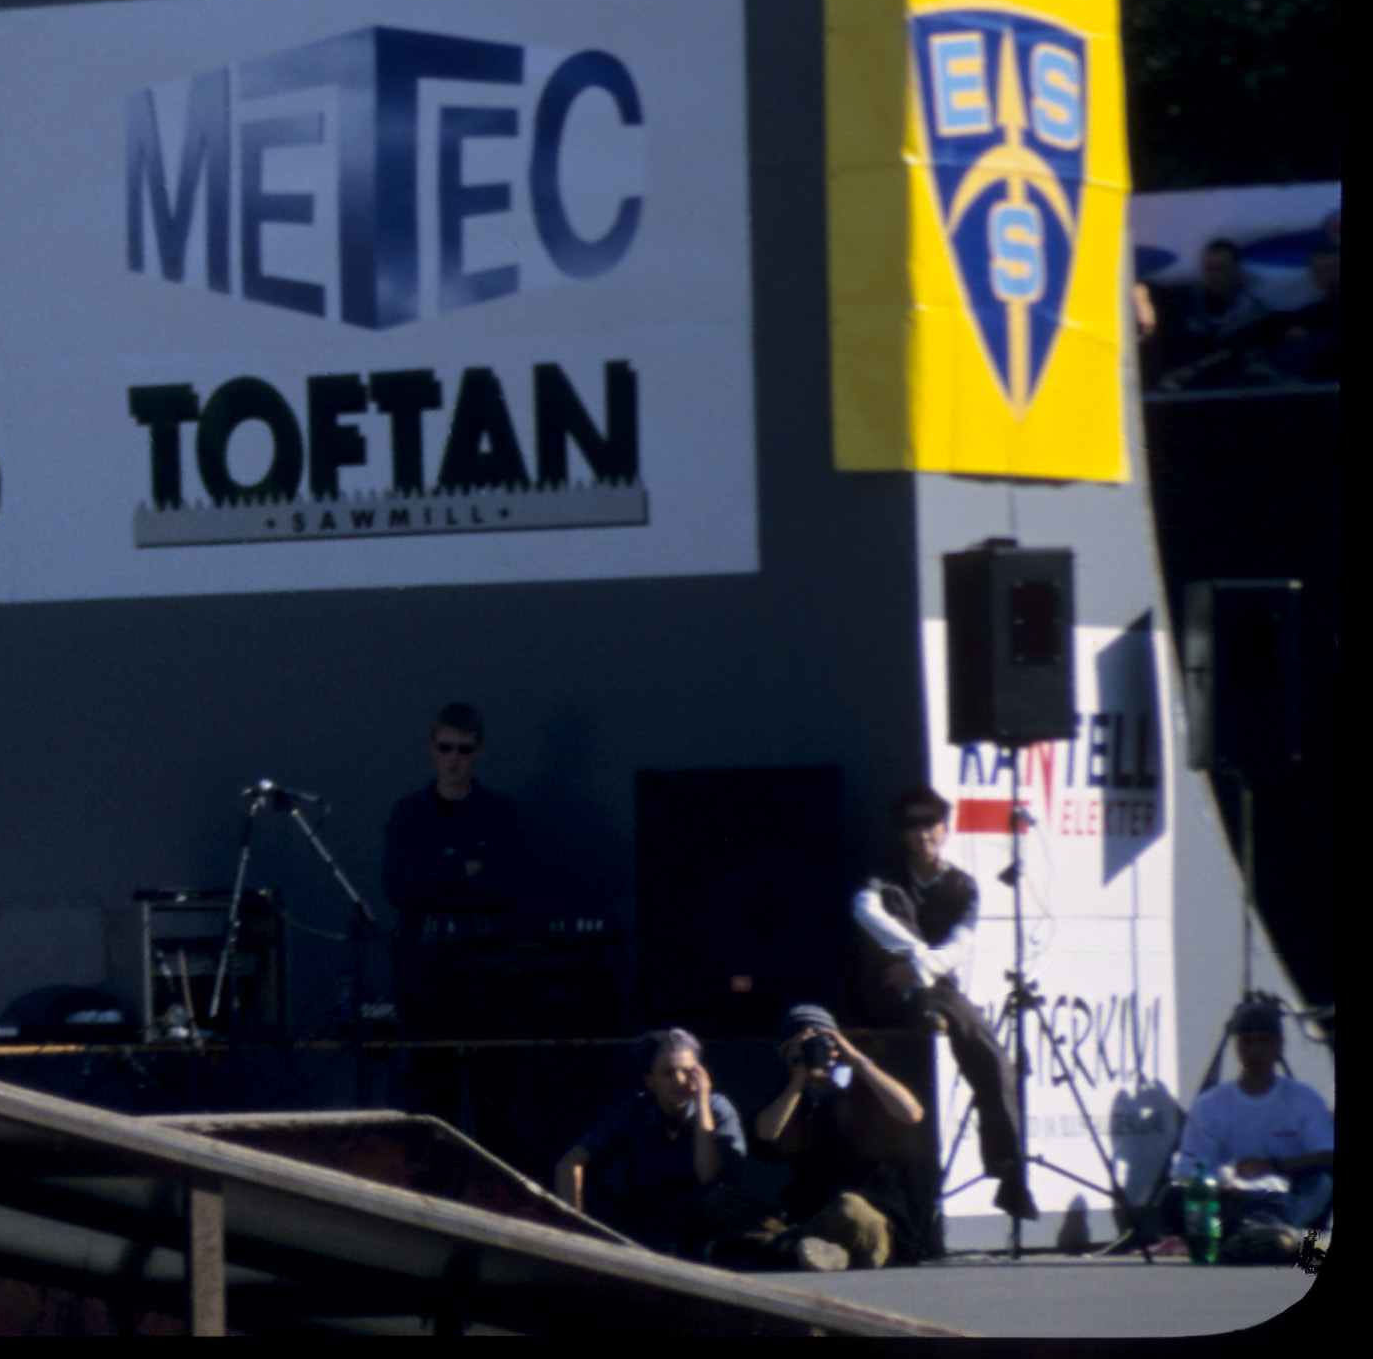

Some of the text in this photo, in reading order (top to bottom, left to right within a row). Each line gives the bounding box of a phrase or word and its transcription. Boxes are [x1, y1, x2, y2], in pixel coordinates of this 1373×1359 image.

[127, 26, 645, 331] METEC
[129, 359, 640, 510] TOFTAN
[292, 505, 484, 533] SAWMILL
